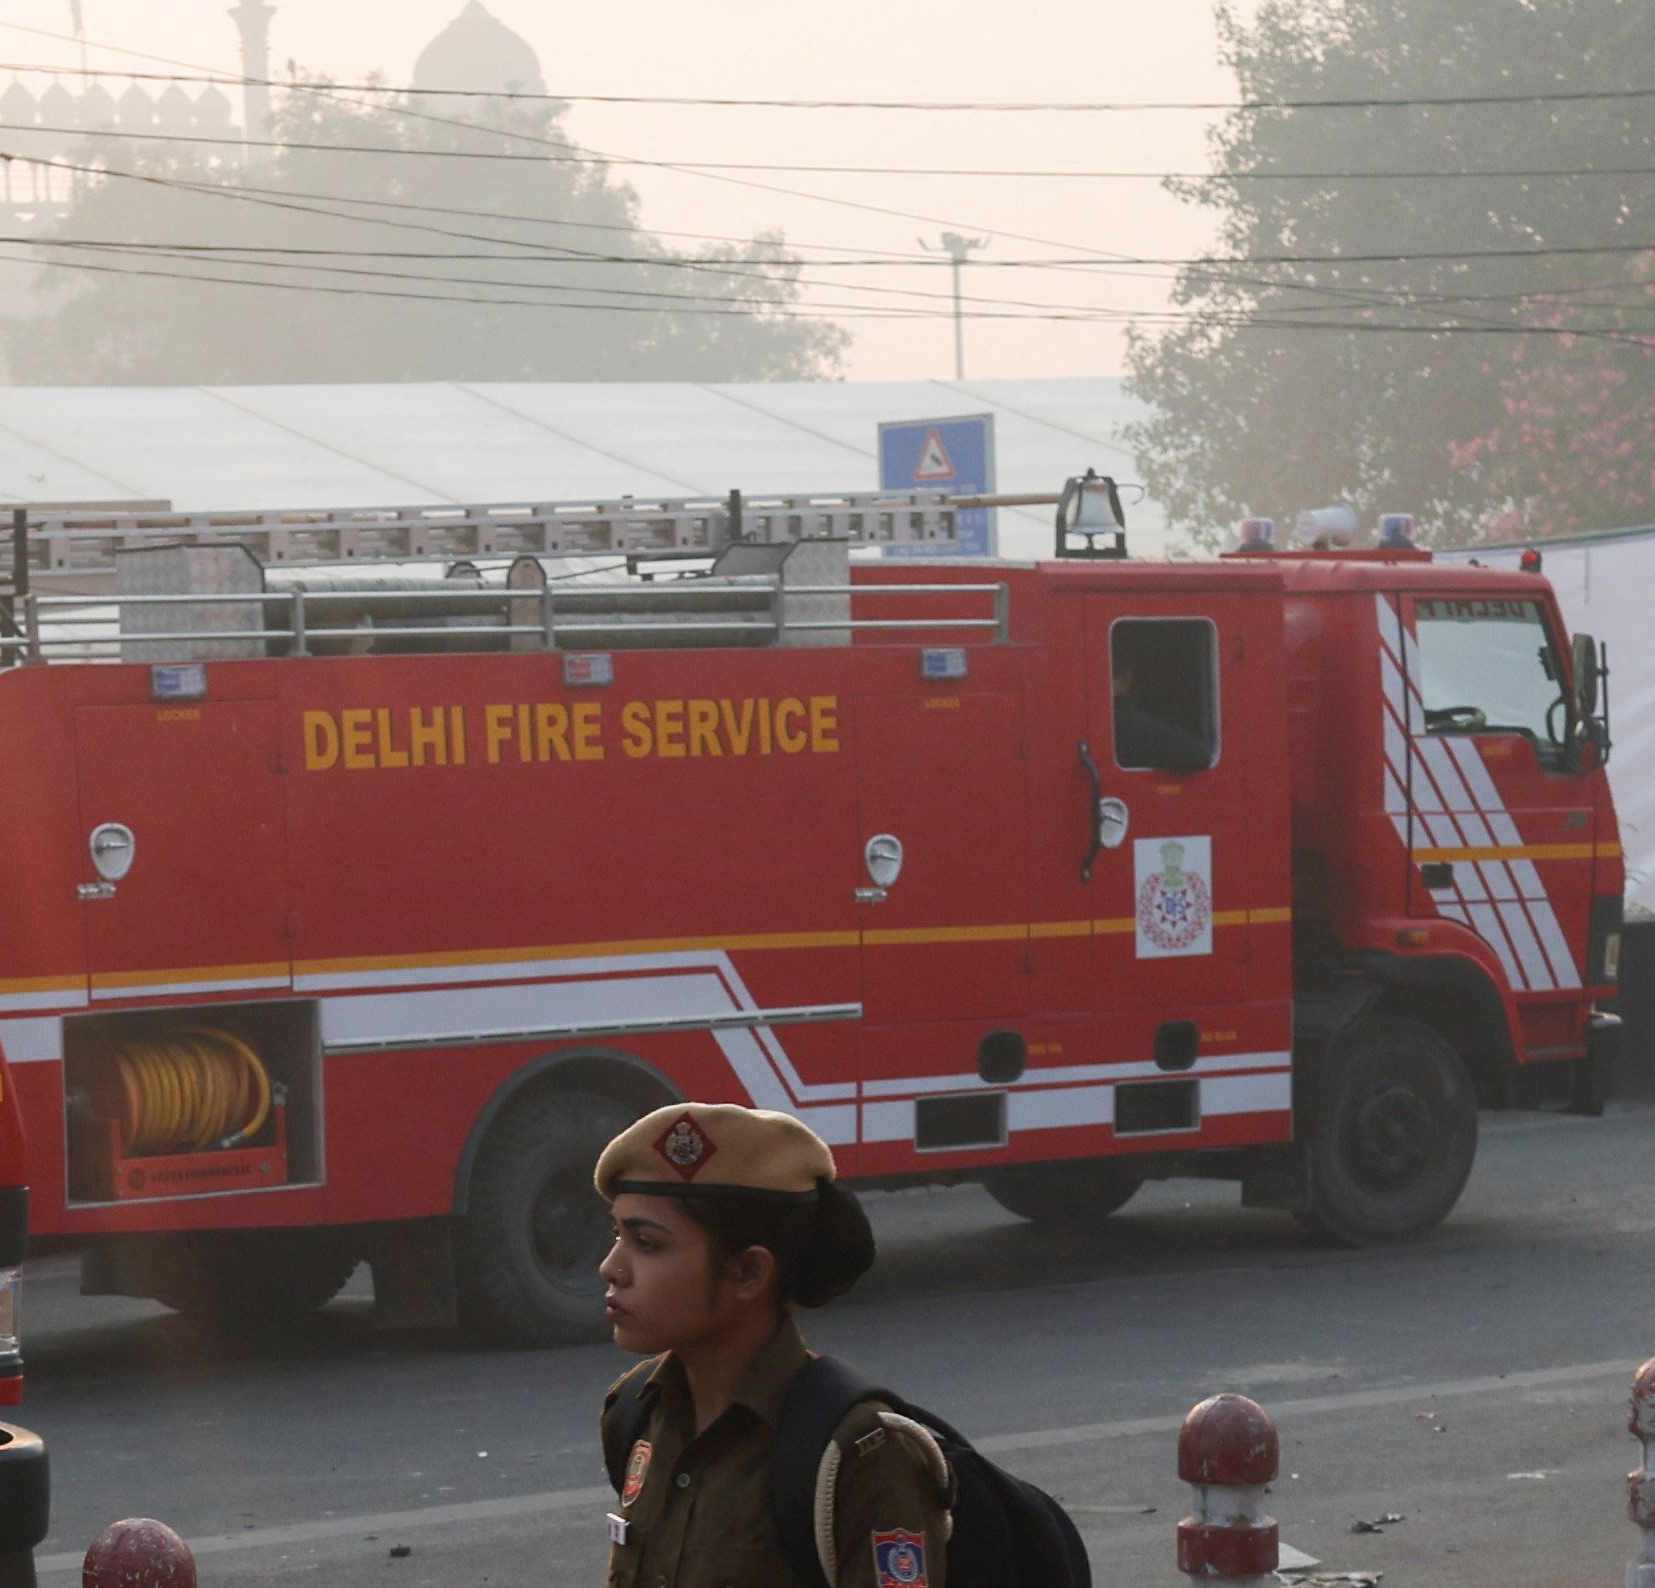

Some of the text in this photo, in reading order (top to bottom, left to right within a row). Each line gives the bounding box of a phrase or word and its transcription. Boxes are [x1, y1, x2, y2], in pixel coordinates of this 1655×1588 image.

[302, 695, 839, 771] DELHI FIRE SERVICE
